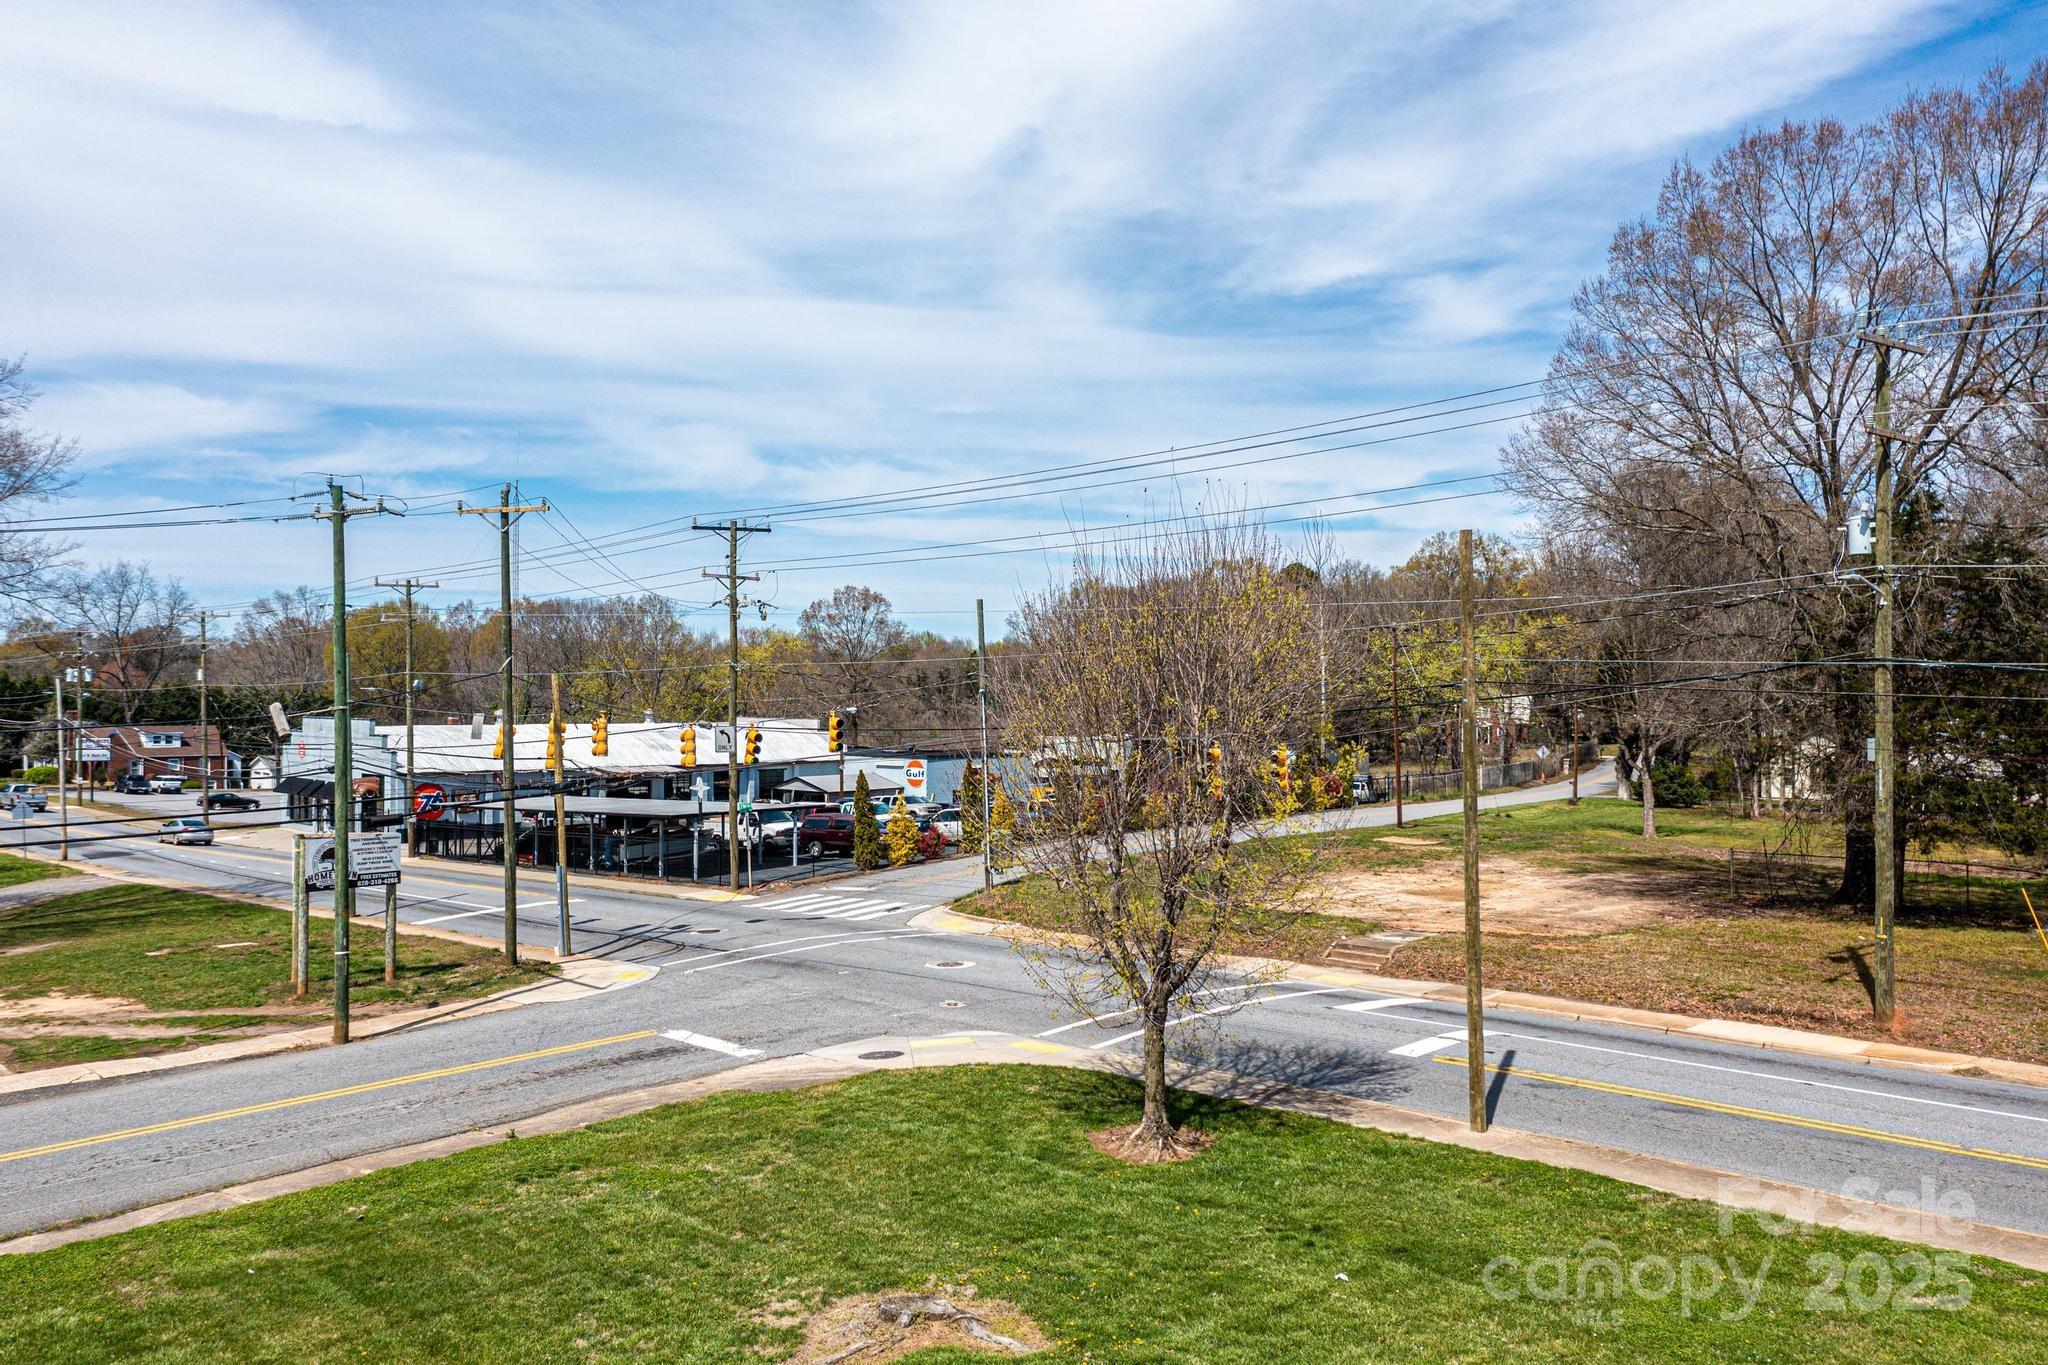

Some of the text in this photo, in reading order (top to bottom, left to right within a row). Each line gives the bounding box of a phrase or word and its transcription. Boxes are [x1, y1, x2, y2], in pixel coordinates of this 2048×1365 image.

[905, 769, 925, 778] Gulf
[417, 791, 445, 814] 76
[307, 871, 357, 883] HOMEN
